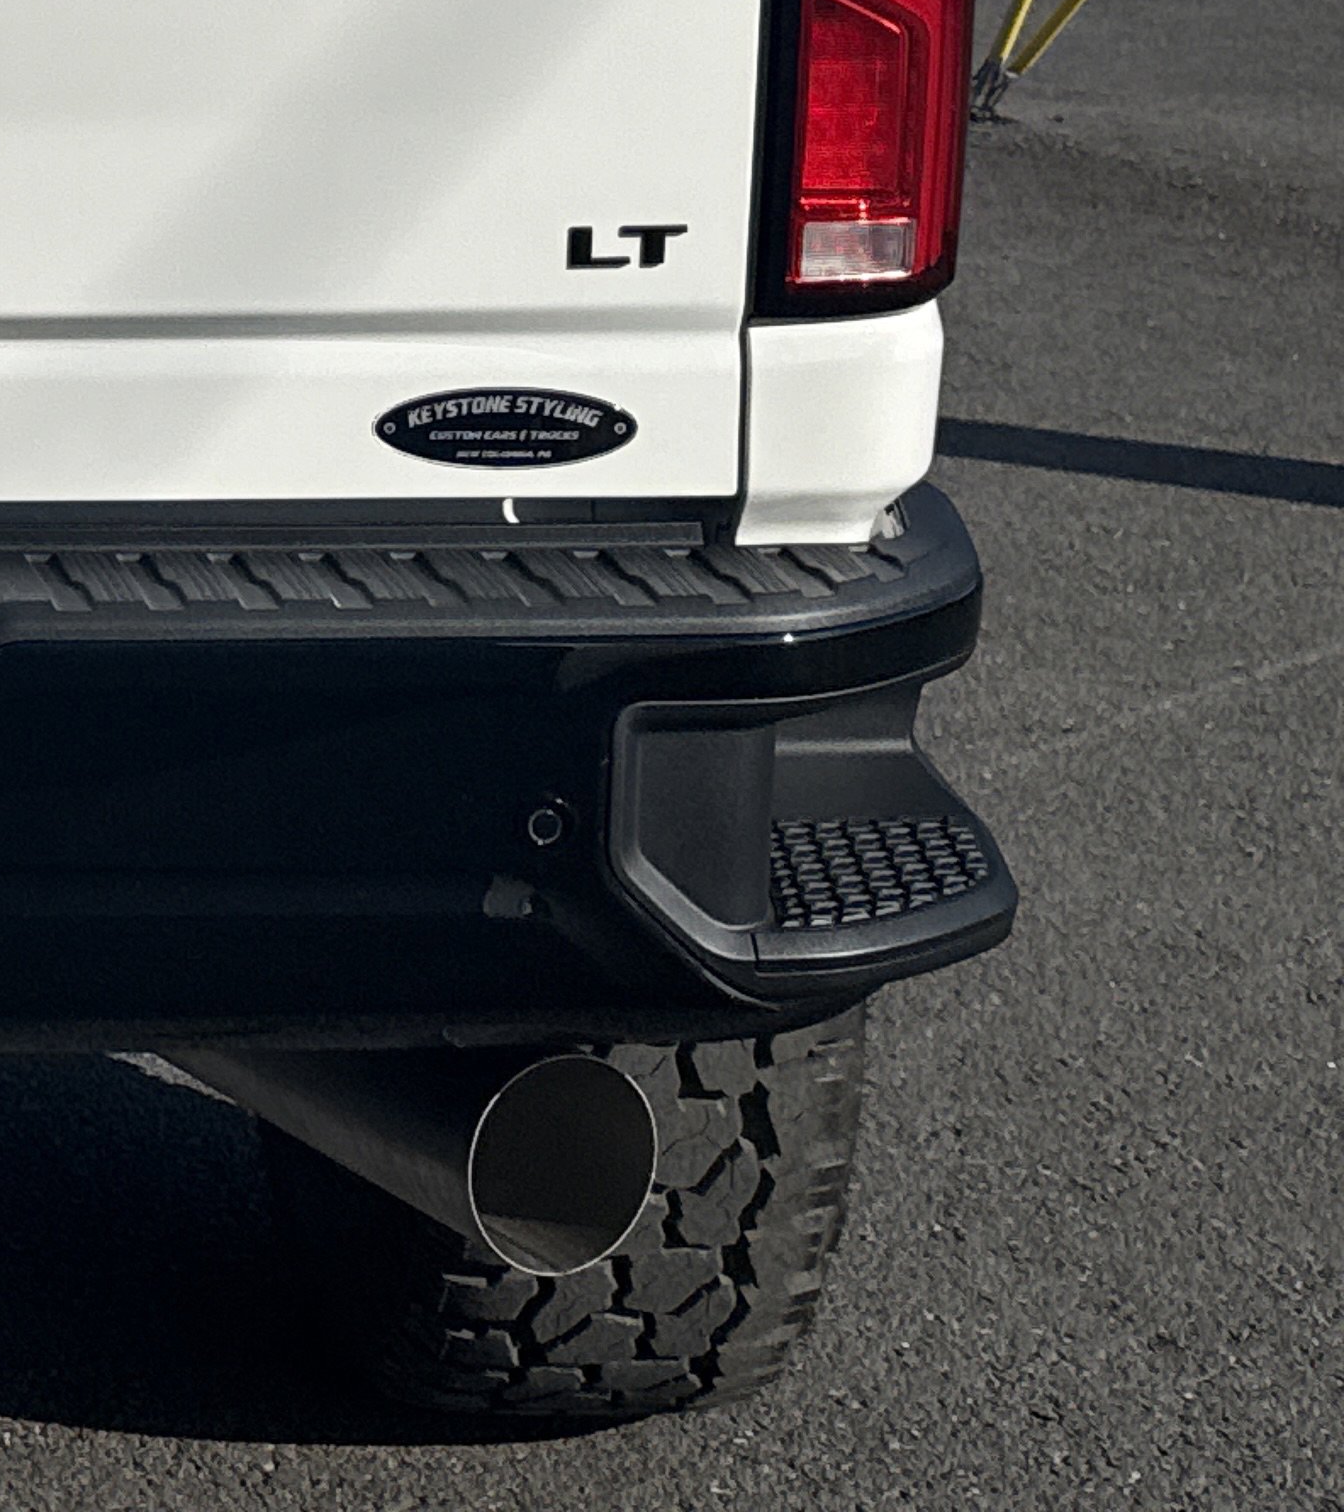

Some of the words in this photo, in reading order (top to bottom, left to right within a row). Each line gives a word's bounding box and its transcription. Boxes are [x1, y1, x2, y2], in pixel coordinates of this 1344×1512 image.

[566, 224, 688, 270] LT
[407, 395, 513, 428] KEYSTONE
[514, 396, 603, 427] STYLING
